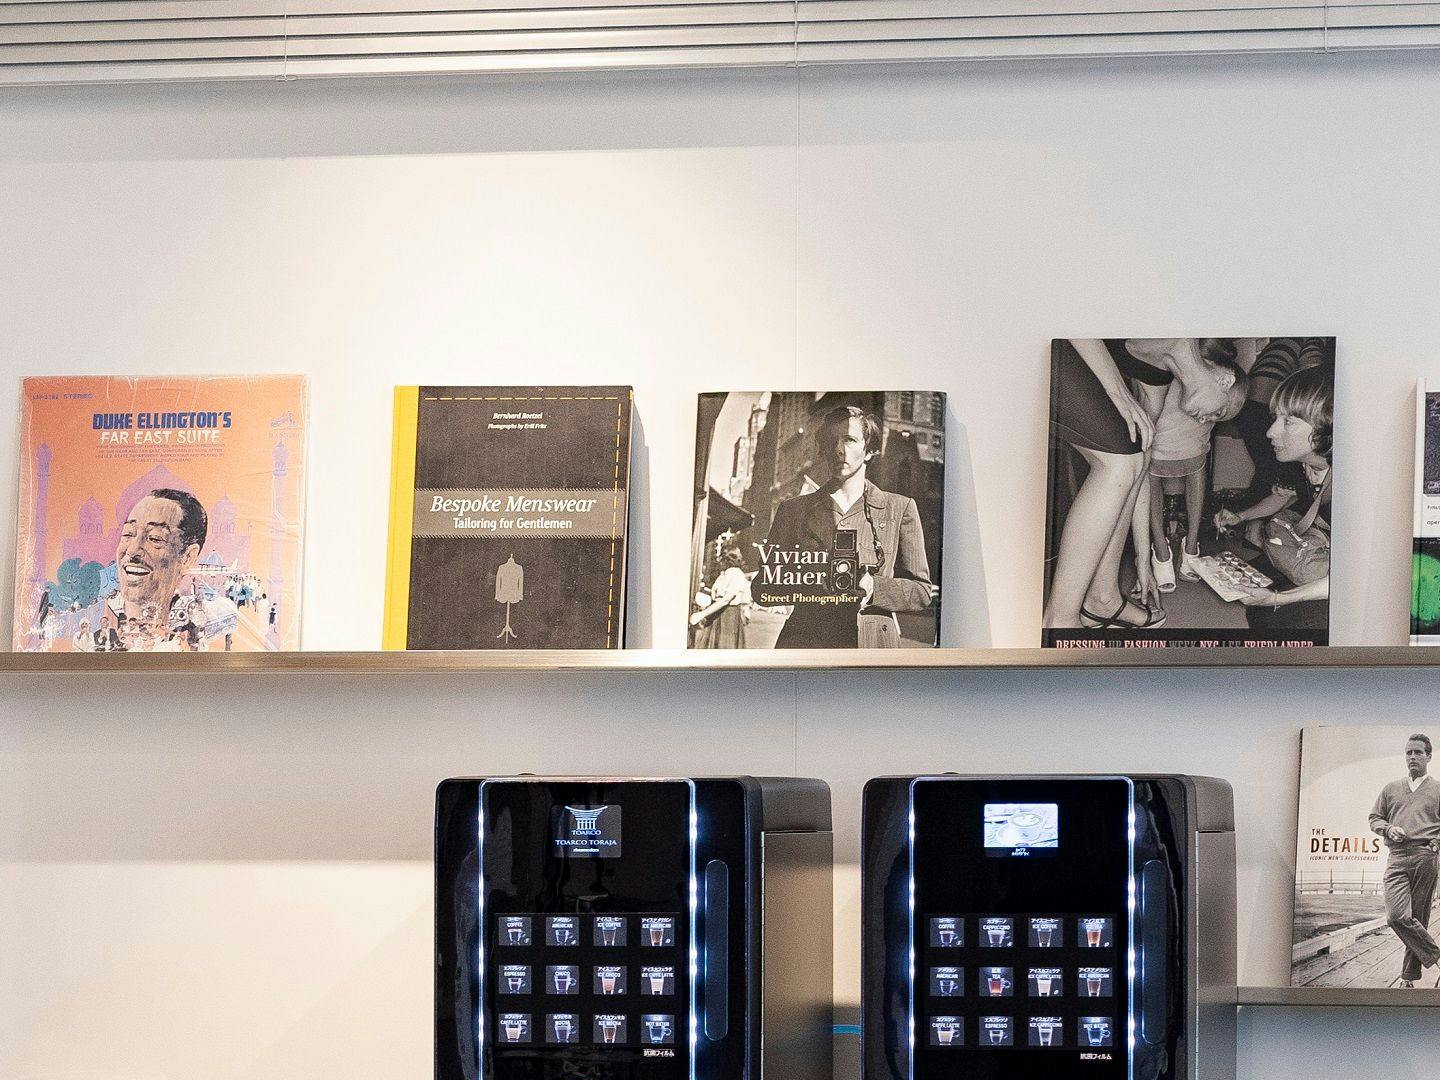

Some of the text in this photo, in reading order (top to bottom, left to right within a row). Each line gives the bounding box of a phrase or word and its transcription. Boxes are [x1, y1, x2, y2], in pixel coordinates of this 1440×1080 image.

[93, 411, 232, 430] DUKE ELLINGTON'S
[100, 429, 221, 444] FAR EAST SUITE
[430, 495, 597, 517] Bespoke Menswear
[453, 517, 572, 531] Tailoring for Gentlemen
[757, 543, 829, 564] Vivian
[761, 564, 827, 585] Maier
[760, 592, 859, 605] Street Photographer
[1124, 640, 1167, 648] FASHION
[1310, 838, 1380, 853] DETAILS
